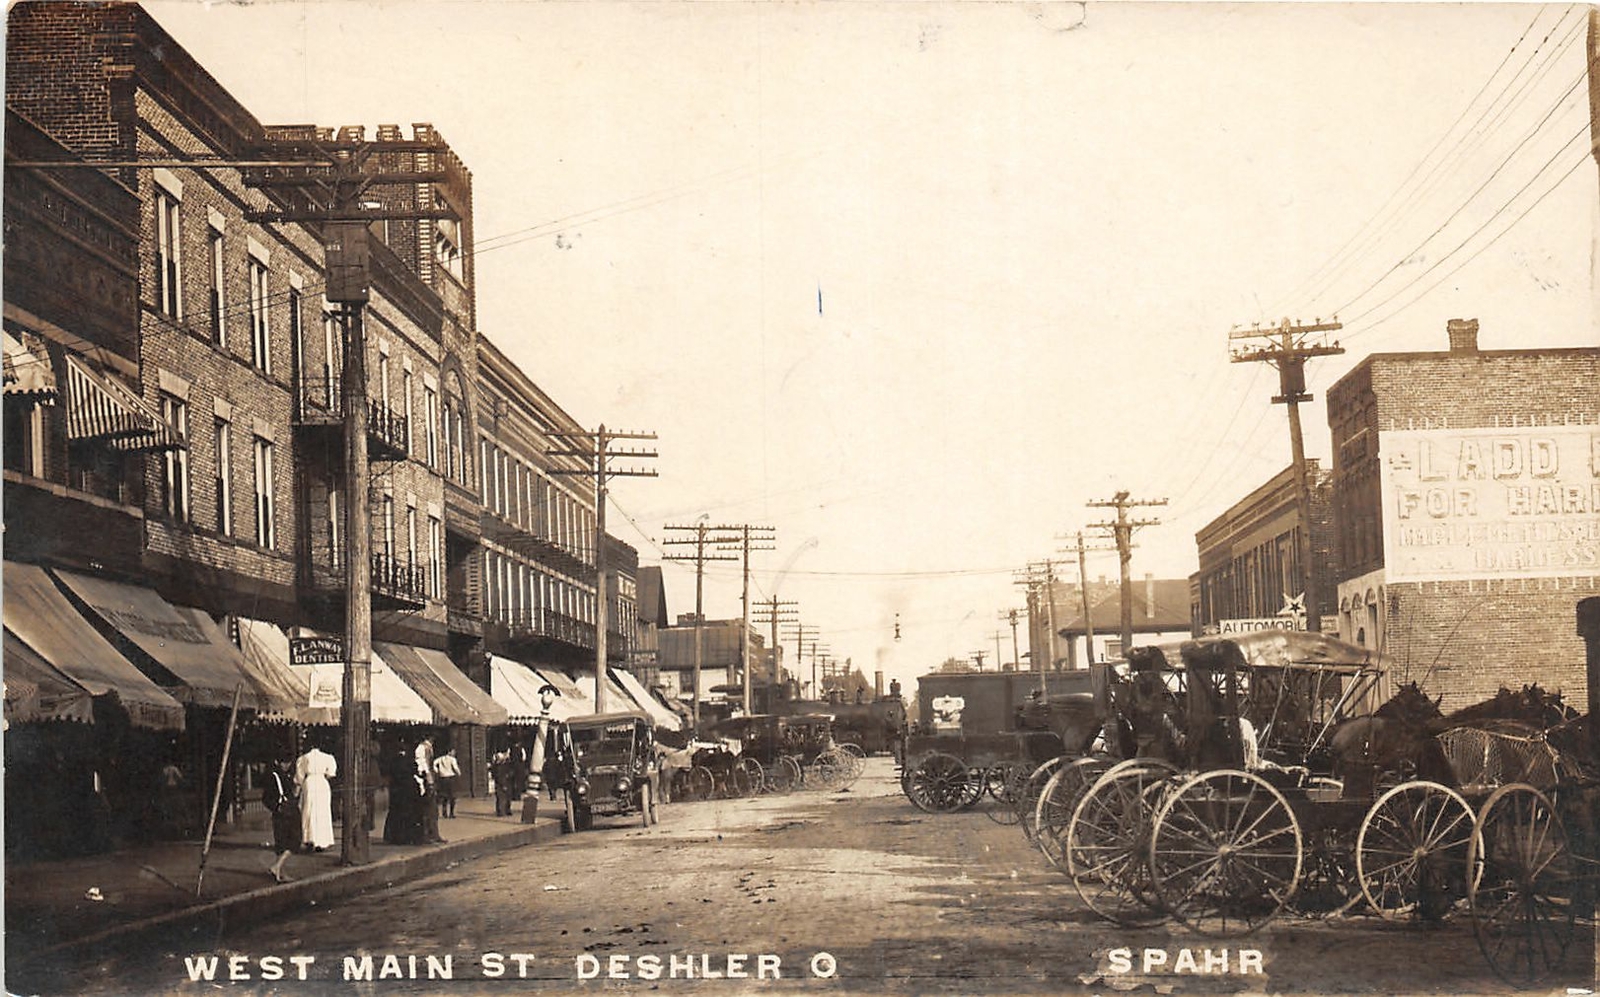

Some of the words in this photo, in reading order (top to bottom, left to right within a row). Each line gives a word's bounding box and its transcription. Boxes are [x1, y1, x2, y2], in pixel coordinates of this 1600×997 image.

[1419, 438, 1559, 481] LADD
[1397, 486, 1478, 519] FOR
[1223, 620, 1307, 634] AUTOMOBIL
[295, 654, 343, 664] DENTIST
